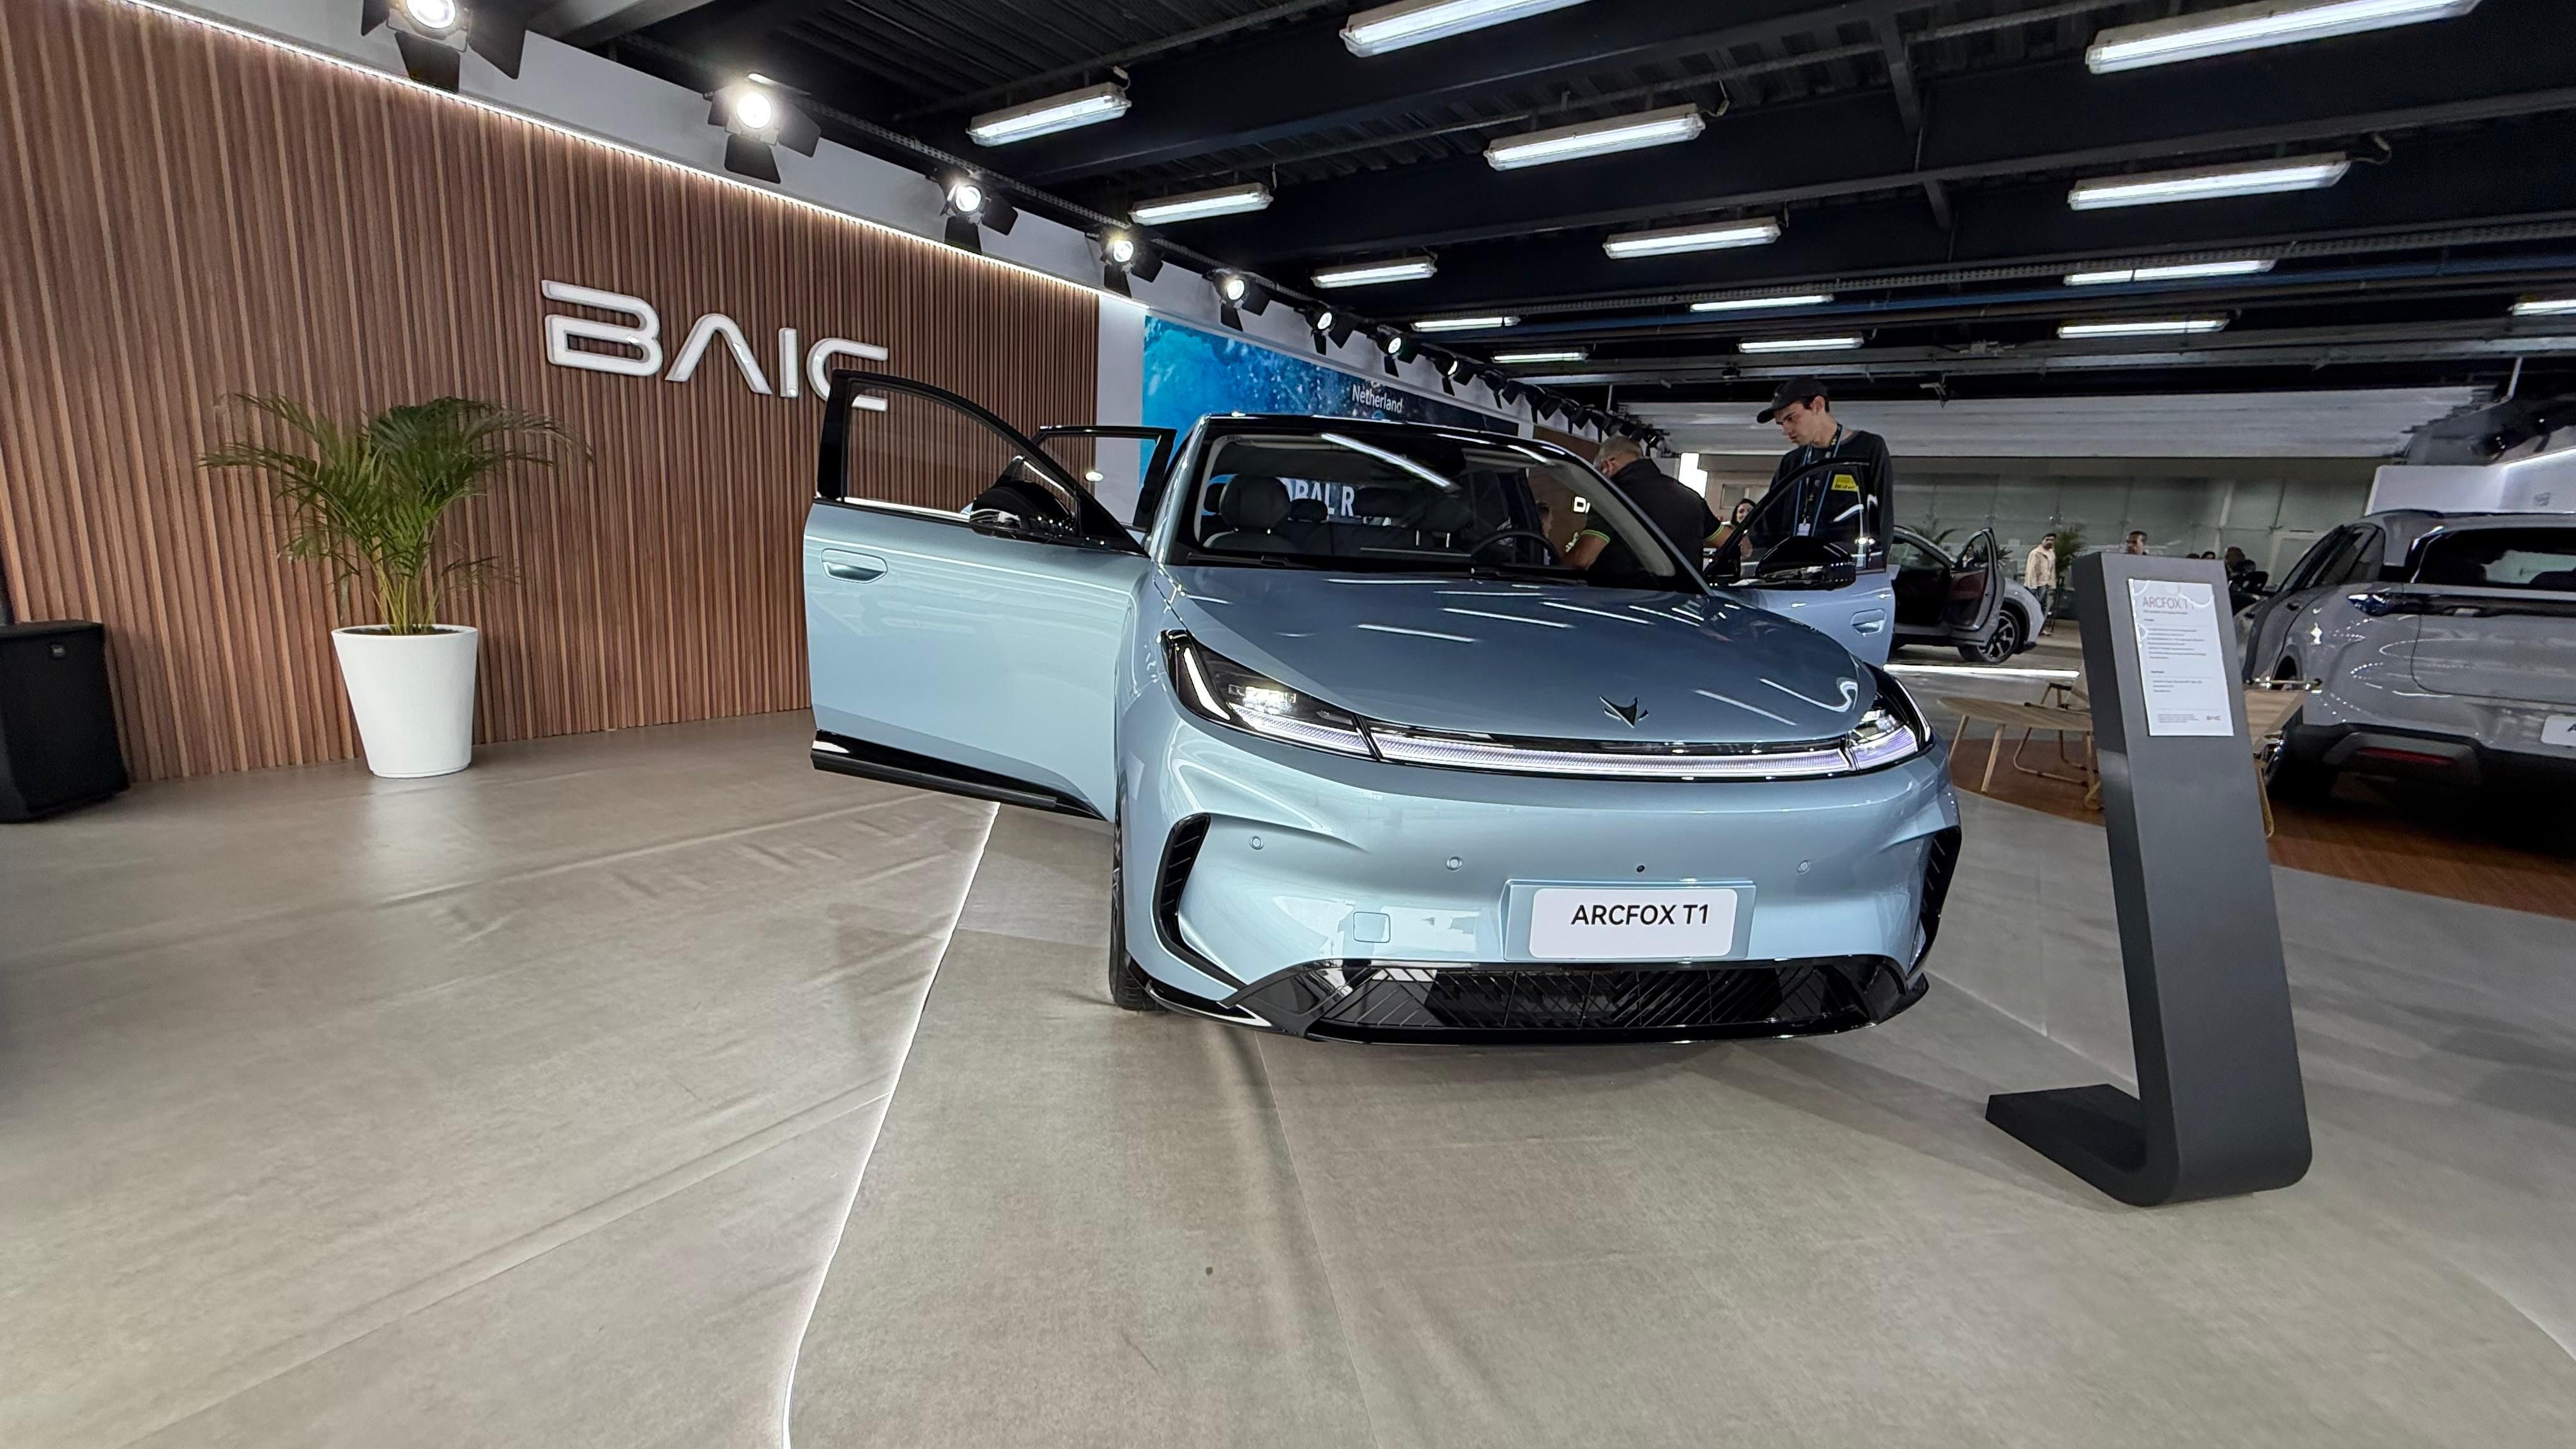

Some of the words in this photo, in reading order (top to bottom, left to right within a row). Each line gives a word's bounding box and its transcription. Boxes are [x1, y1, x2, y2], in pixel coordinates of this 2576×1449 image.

[542, 280, 888, 412] BAIC
[1352, 384, 1403, 413] Netherland
[2143, 596, 2181, 610] ARCFOX
[1570, 904, 1678, 926] ARCFOX
[1682, 903, 1709, 924] T1
